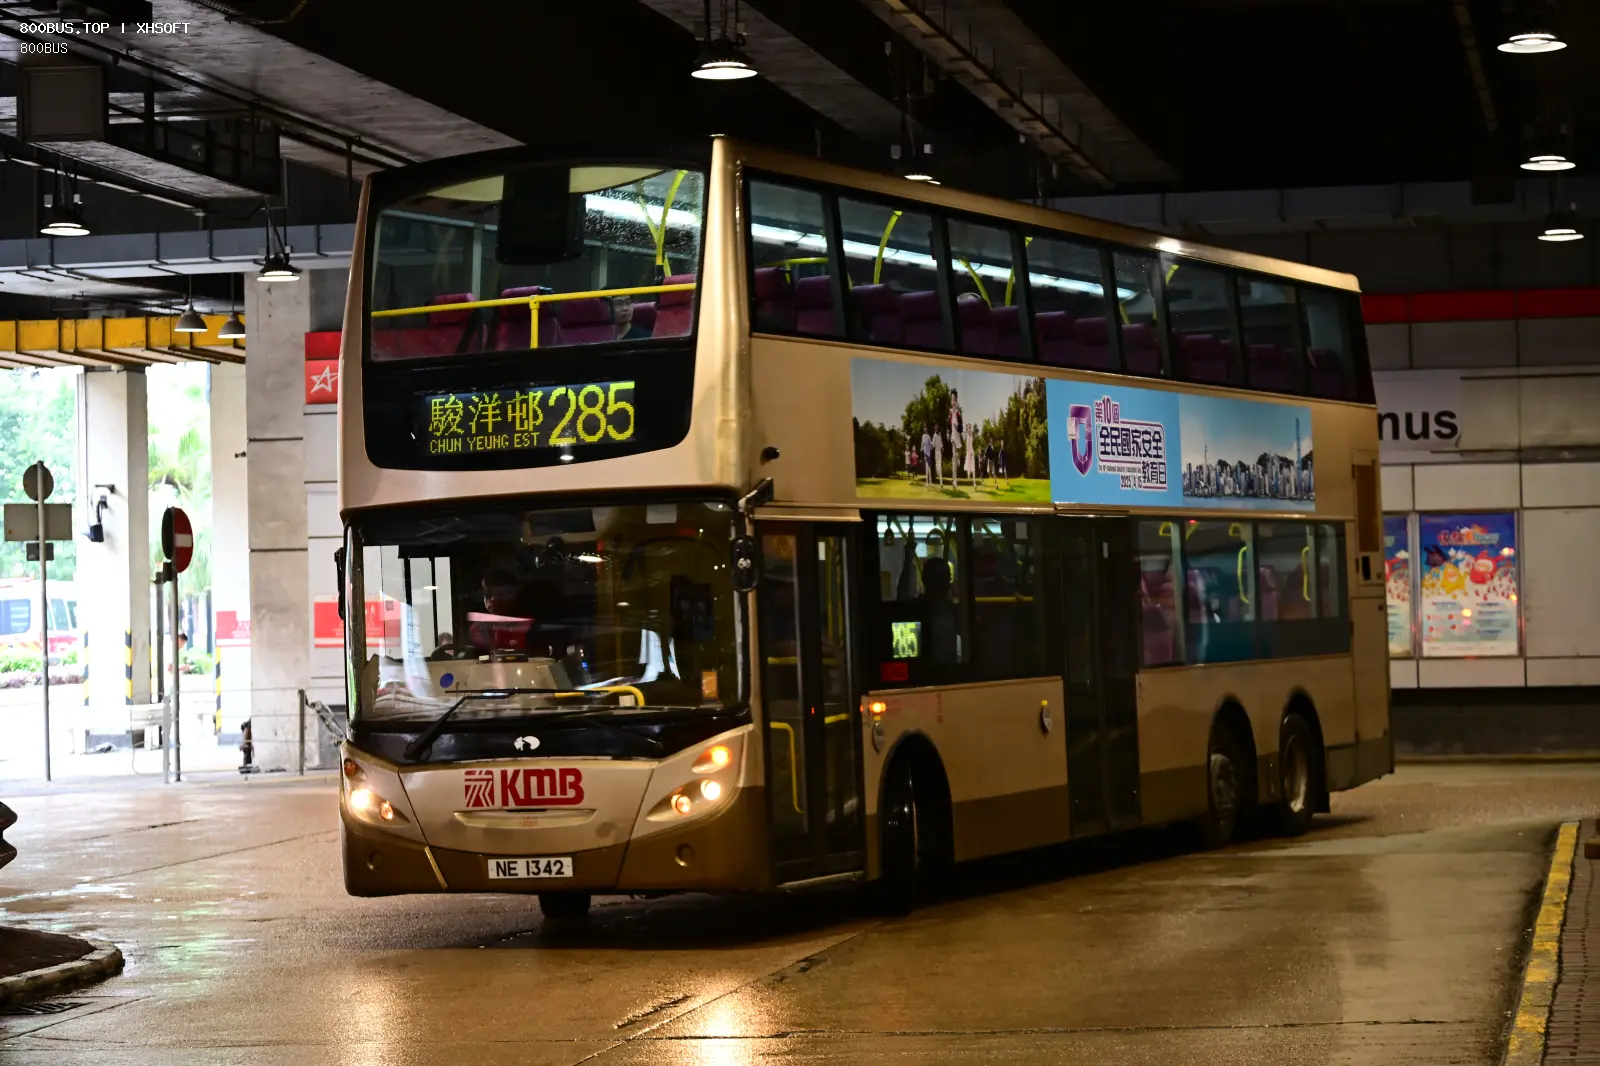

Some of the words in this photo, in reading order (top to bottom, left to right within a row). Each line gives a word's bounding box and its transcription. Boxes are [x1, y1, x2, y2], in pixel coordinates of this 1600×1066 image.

[429, 391, 544, 436] 駿洋邨
[548, 381, 636, 446] 285
[429, 438, 462, 454] CHUN
[467, 434, 509, 451] YEUNG
[514, 432, 540, 447] EST
[1100, 426, 1163, 459] 全民國家安全
[1142, 461, 1167, 485] 教育日
[500, 768, 585, 807] KMB
[496, 860, 519, 877] NE
[526, 859, 565, 876] 1342
